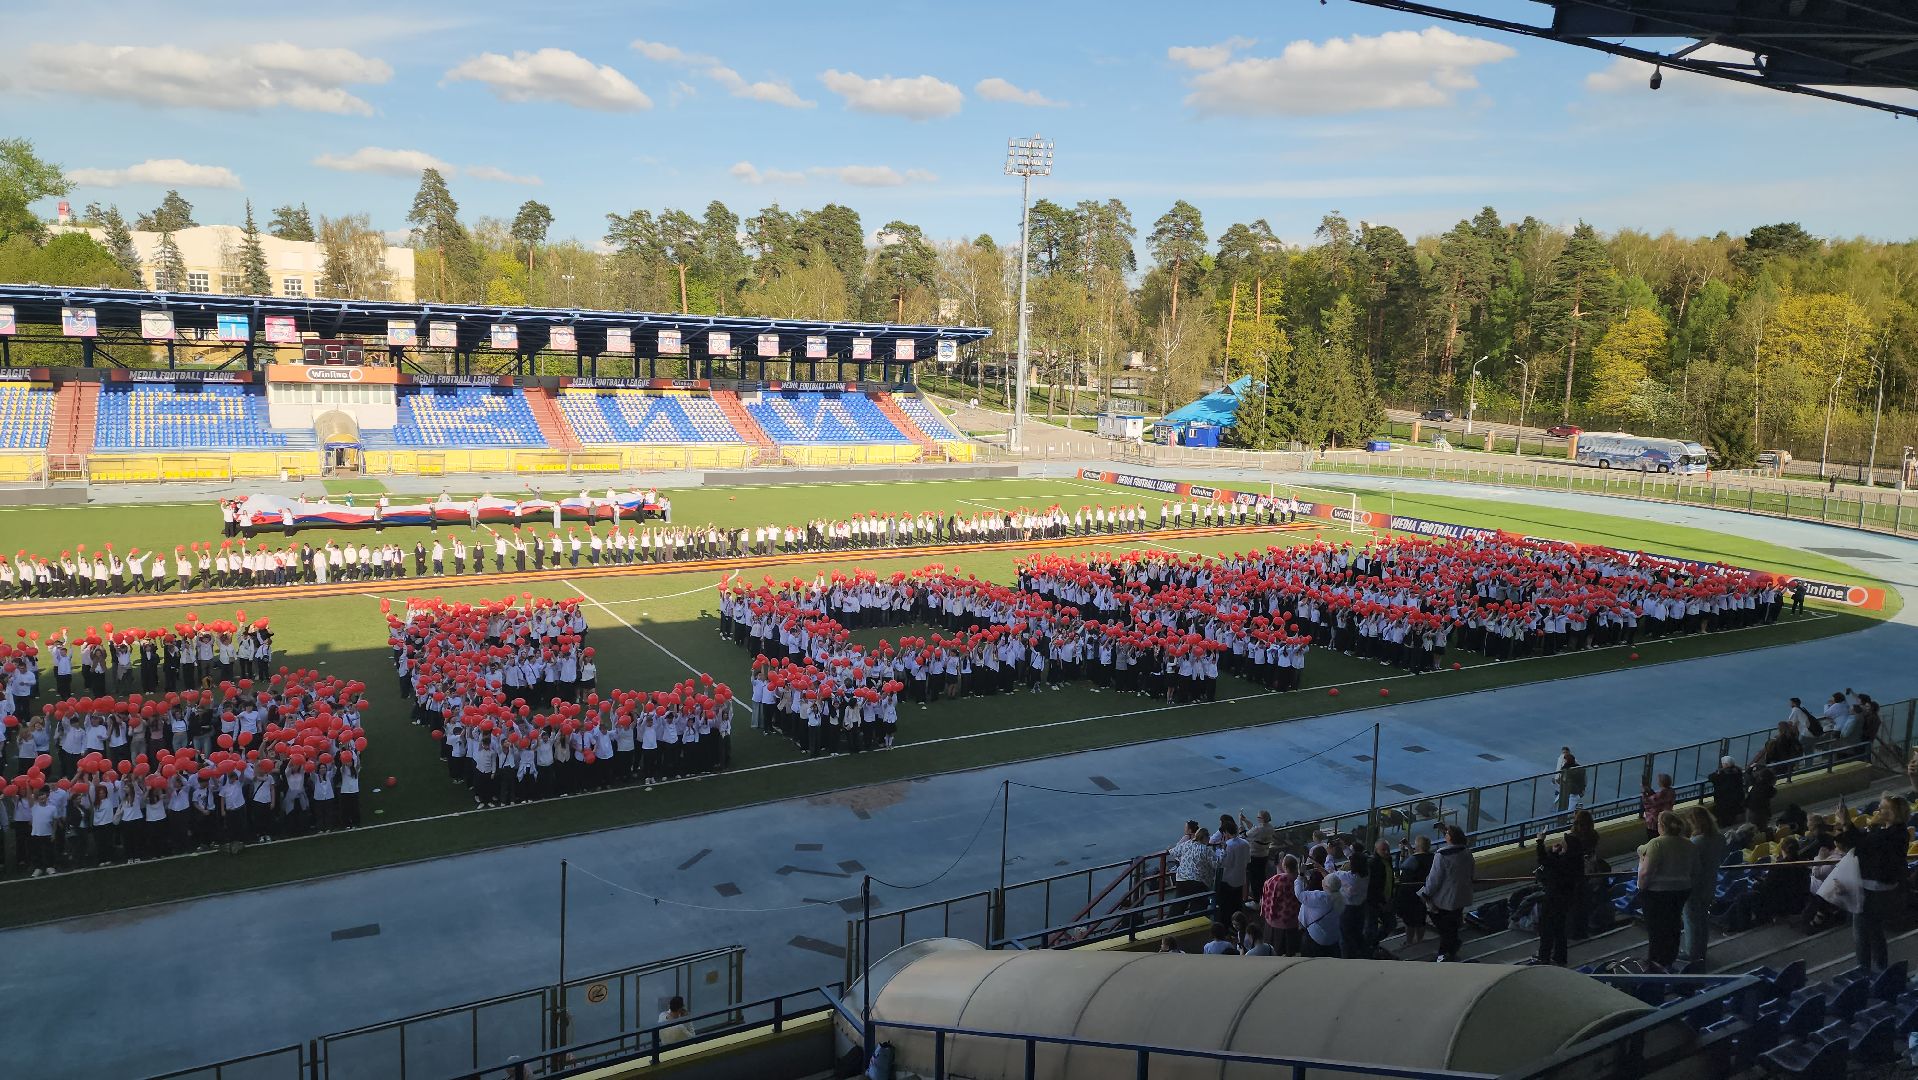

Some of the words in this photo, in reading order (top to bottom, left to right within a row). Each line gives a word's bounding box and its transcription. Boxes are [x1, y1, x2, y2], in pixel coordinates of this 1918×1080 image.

[128, 370, 158, 381] MEDIA
[159, 371, 201, 381] FOOTBALL
[203, 371, 237, 381] LEAGUE
[412, 374, 436, 384] MEDIA
[436, 375, 472, 385] FOOTBALL
[472, 375, 500, 385] LEAGUE
[571, 377, 593, 387] MEDIA
[594, 378, 625, 387] FOOTBALL
[625, 378, 650, 388] LEAGUE
[1392, 517, 1418, 531] MEDIA
[1417, 521, 1459, 538] FOOTBALL
[1803, 582, 1844, 599] inline
